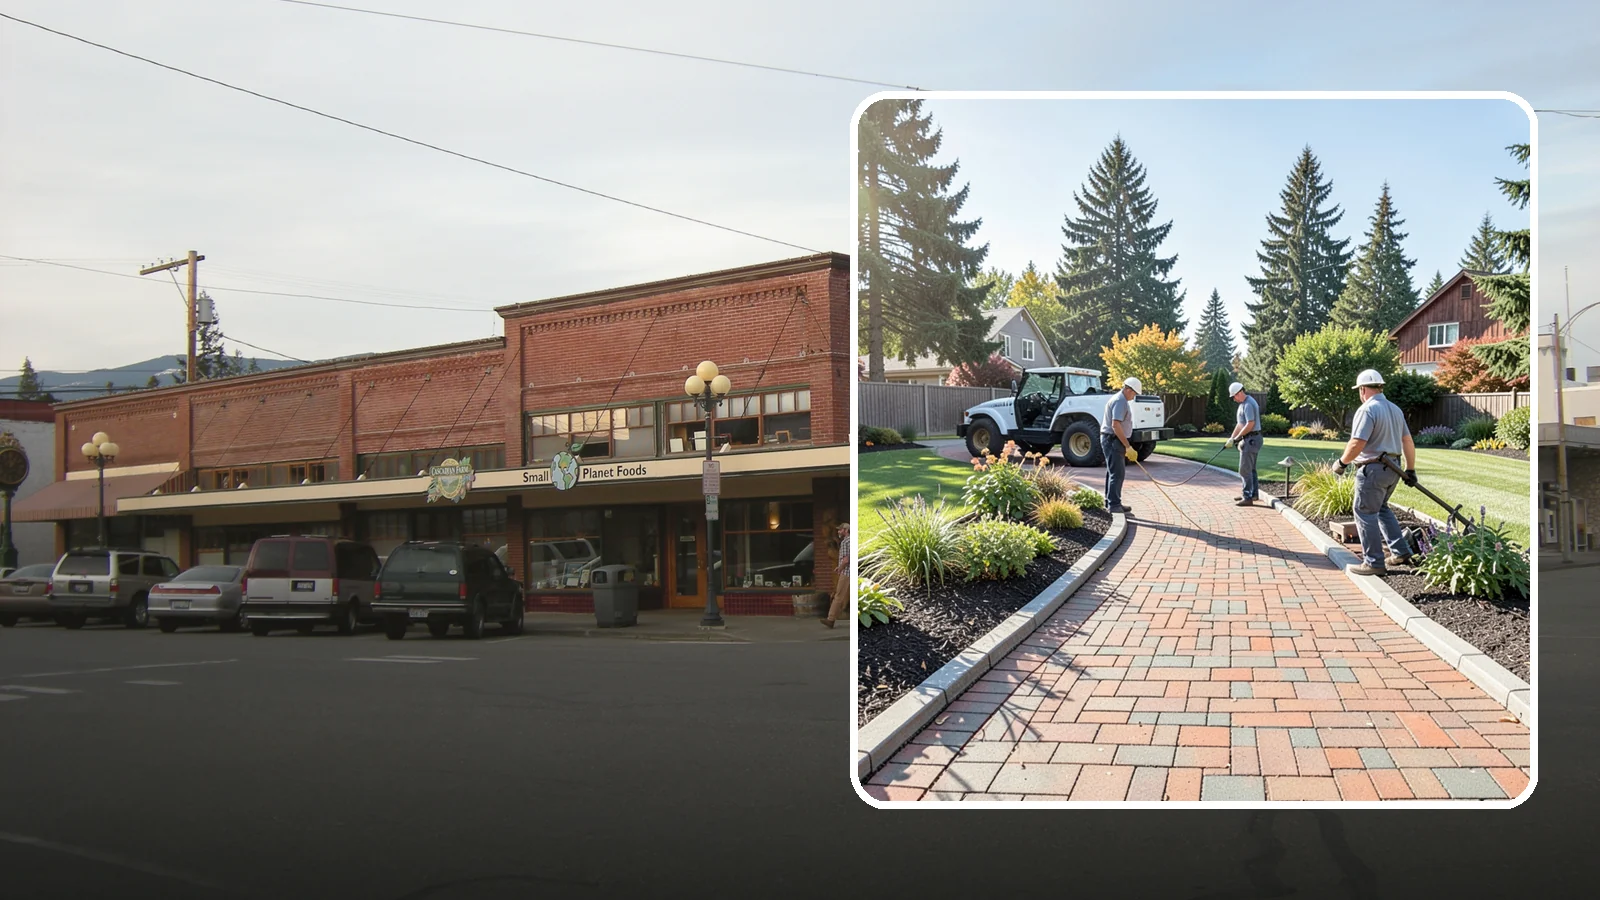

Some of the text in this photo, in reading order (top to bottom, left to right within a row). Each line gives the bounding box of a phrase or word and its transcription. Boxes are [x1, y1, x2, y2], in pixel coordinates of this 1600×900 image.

[523, 464, 647, 483] Small Planet Foods
